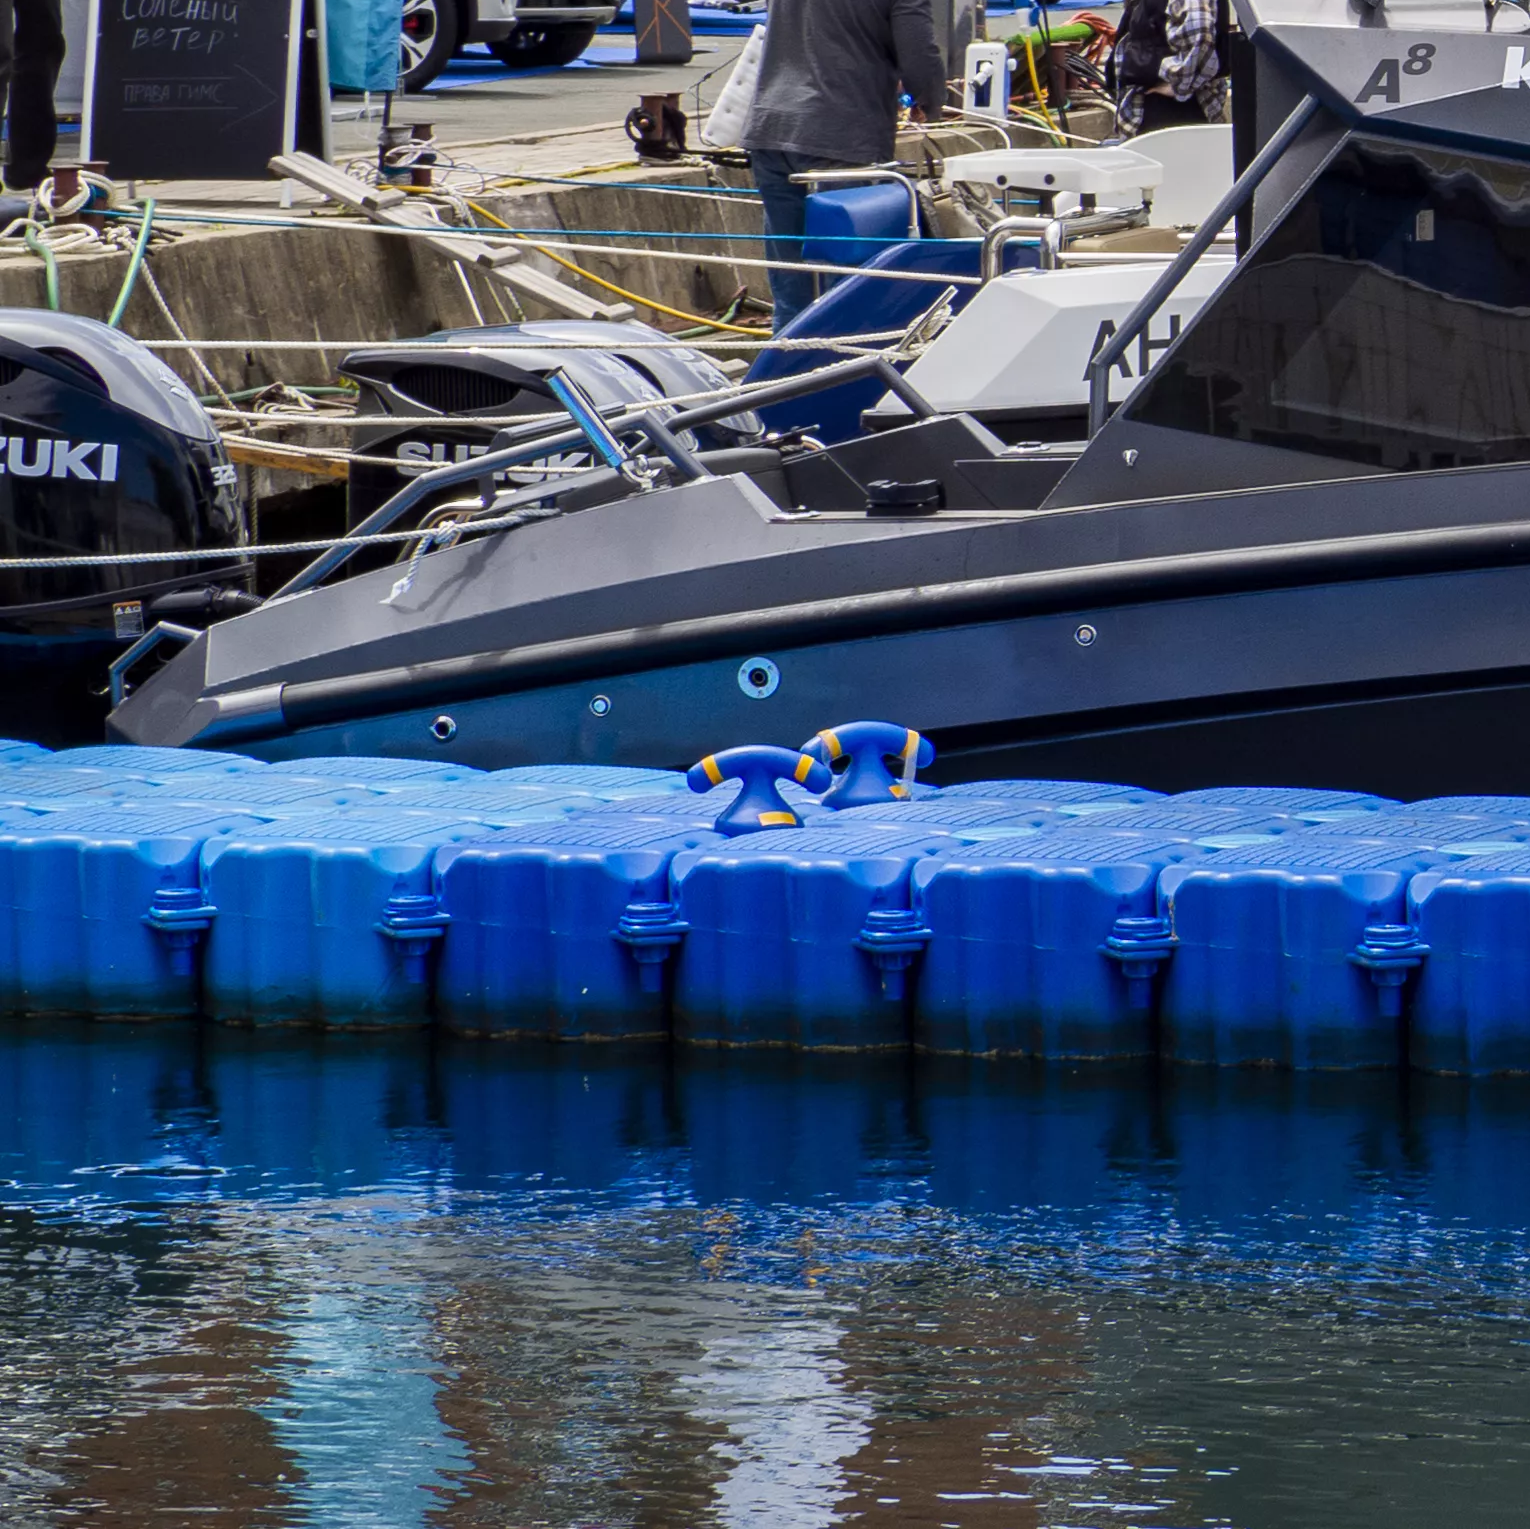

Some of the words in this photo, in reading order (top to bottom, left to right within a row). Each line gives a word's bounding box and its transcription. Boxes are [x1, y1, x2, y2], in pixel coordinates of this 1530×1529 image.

[131, 25, 225, 54] ветер
[0, 436, 119, 482] UKI
[396, 441, 594, 484] SUUK
